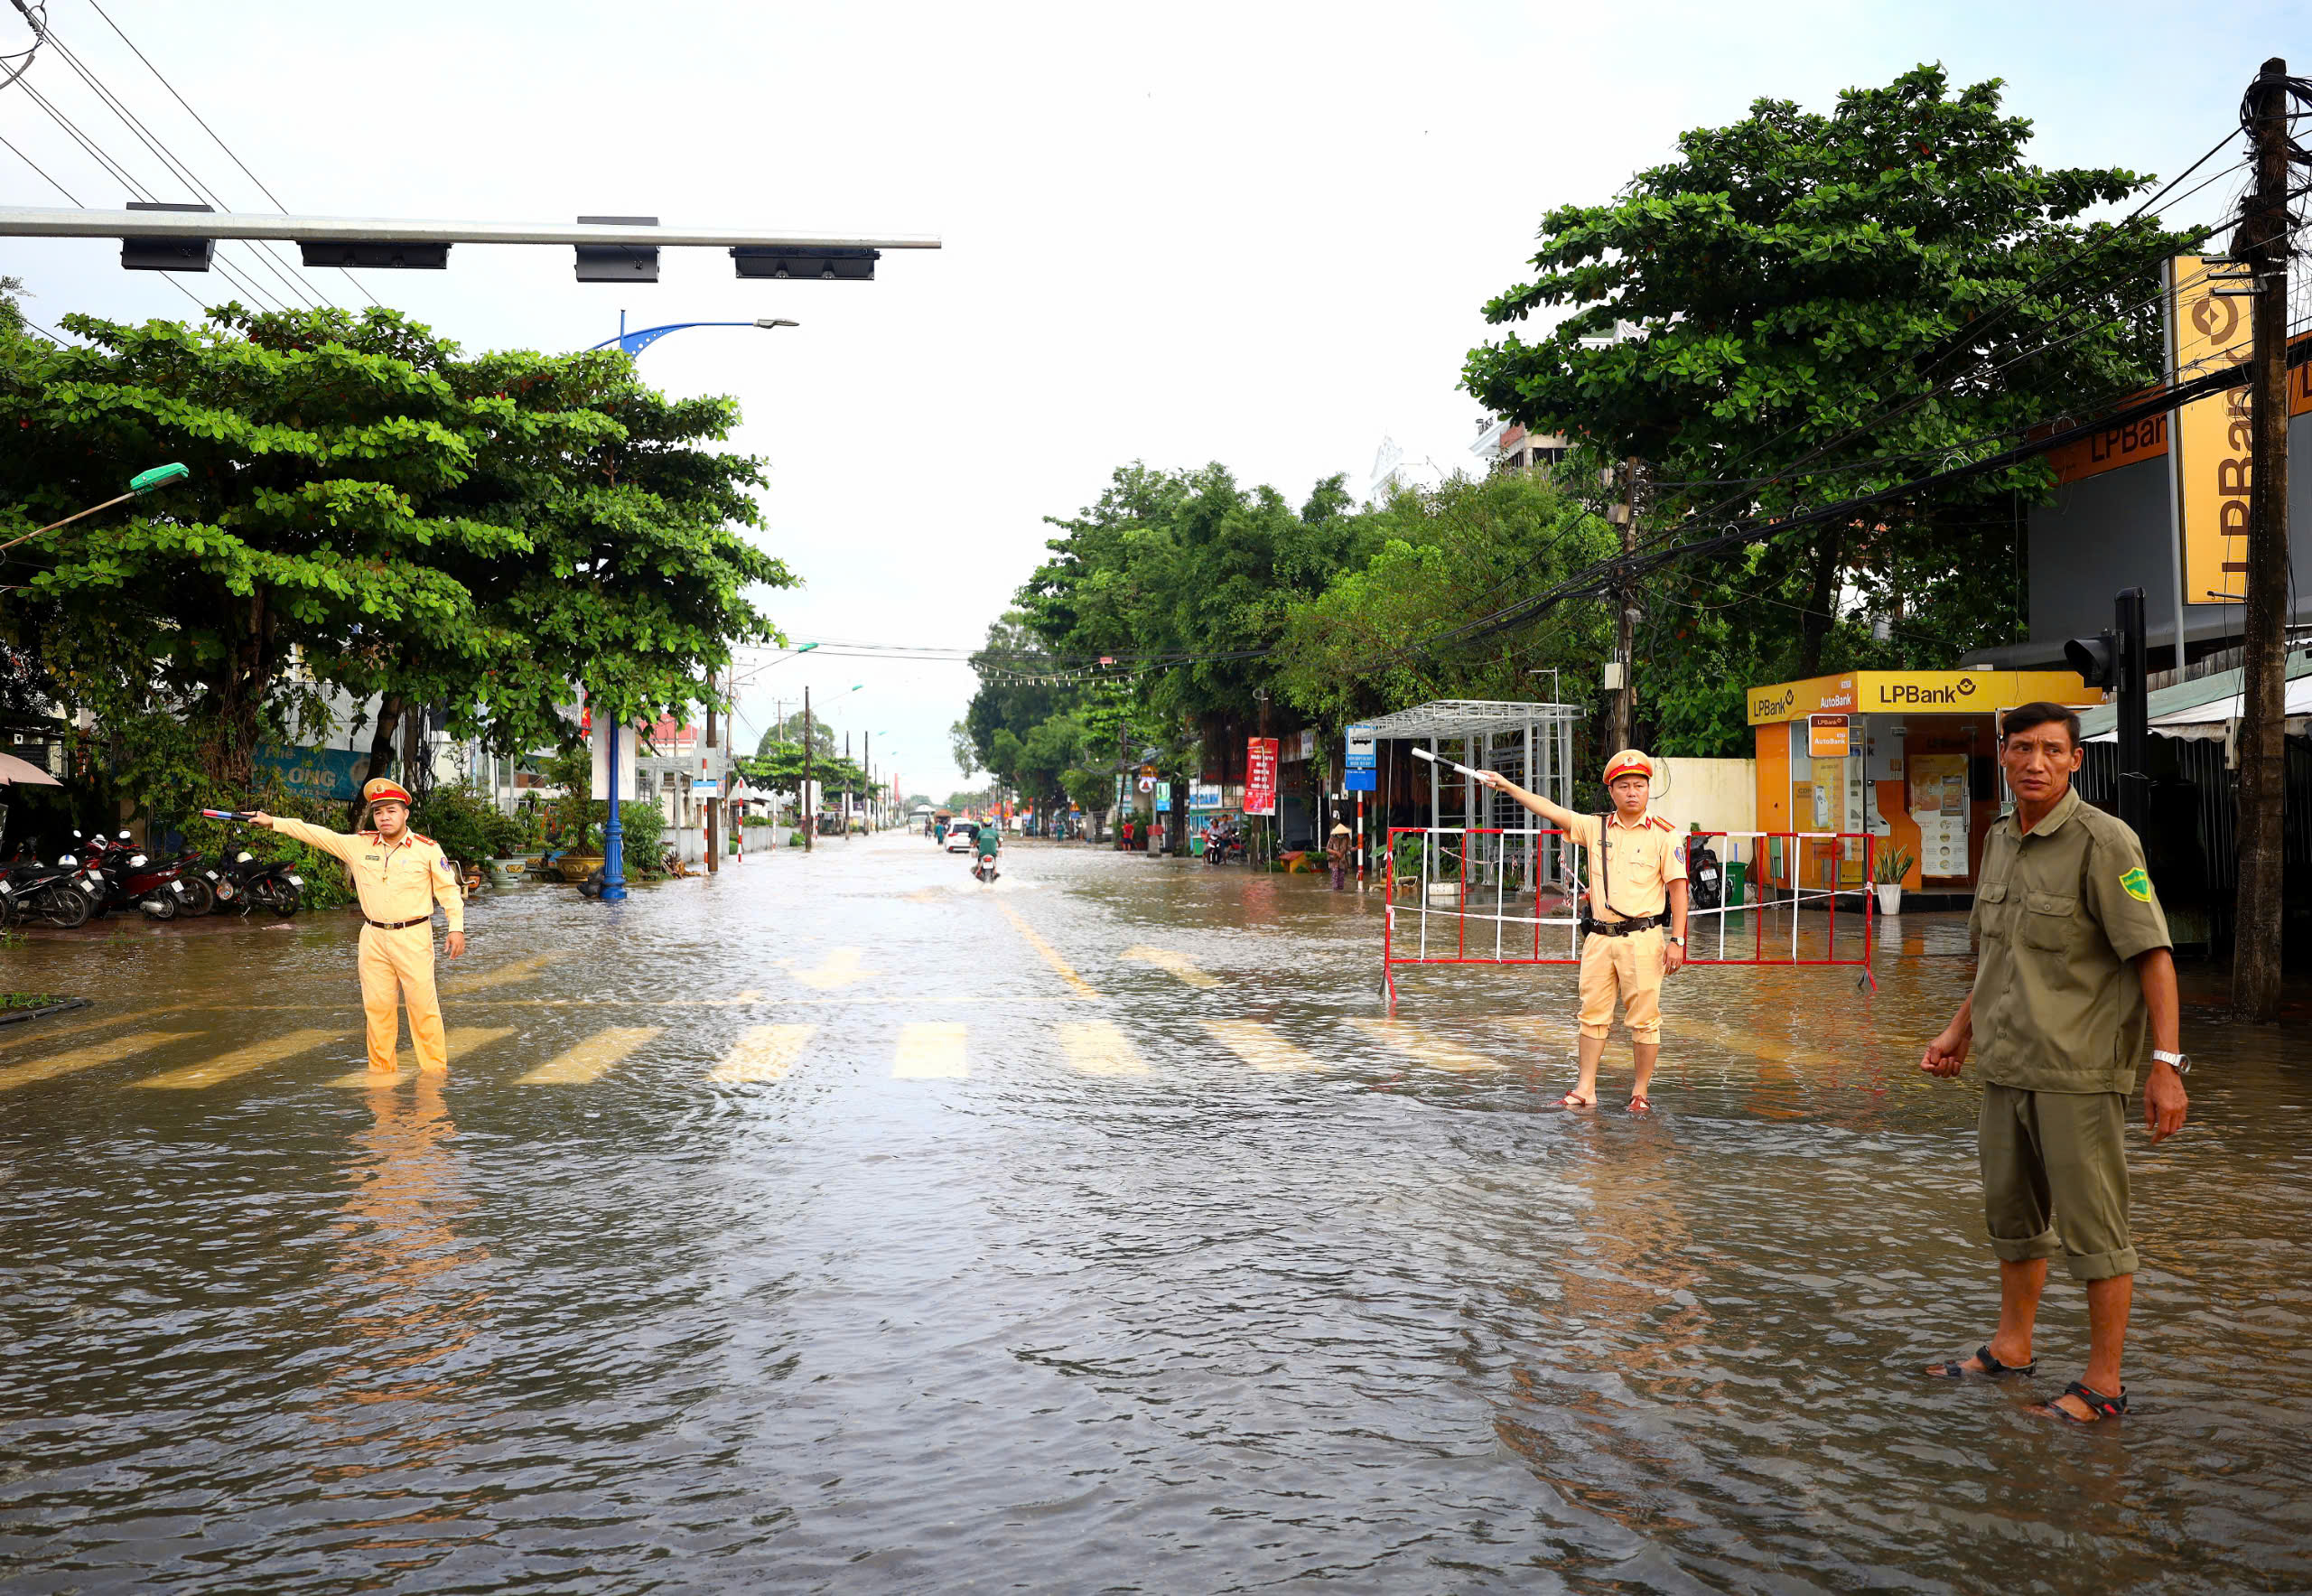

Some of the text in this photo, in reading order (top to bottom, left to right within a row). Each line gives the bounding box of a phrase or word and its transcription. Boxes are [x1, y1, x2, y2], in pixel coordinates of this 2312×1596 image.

[1821, 694, 1851, 709] AutoBank
[1880, 685, 1956, 704] LPBank
[1753, 696, 1785, 717] LPBank
